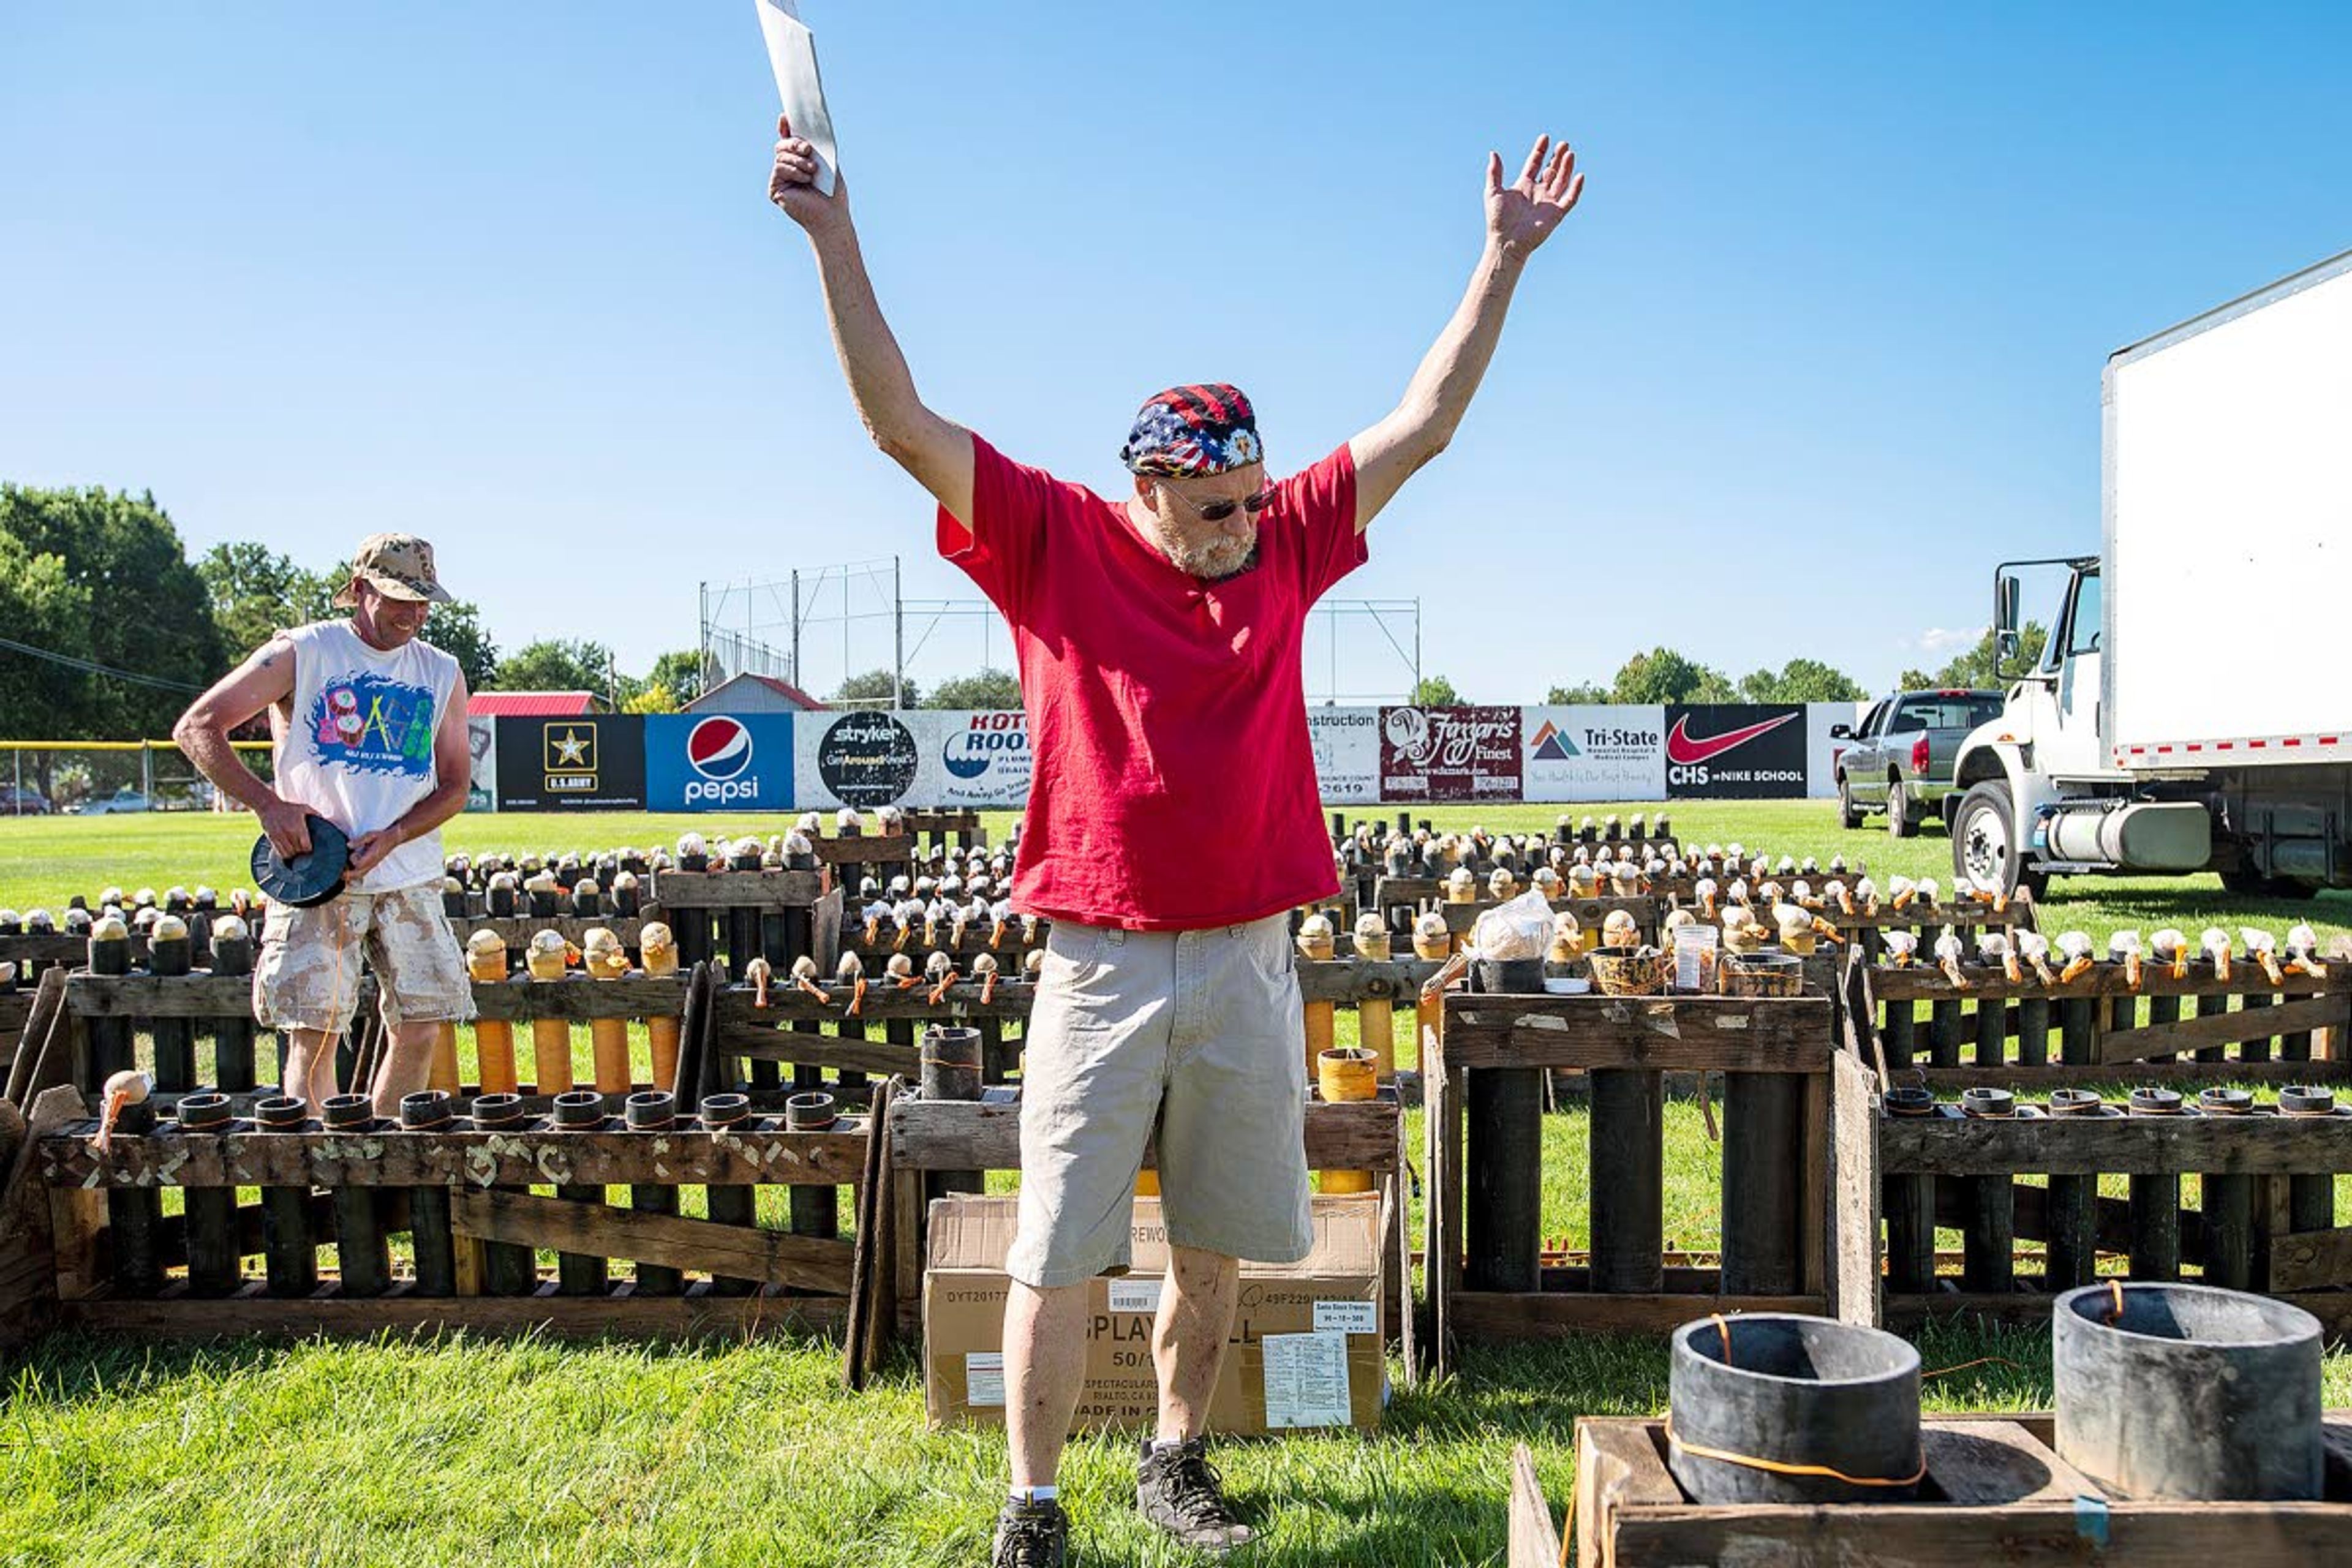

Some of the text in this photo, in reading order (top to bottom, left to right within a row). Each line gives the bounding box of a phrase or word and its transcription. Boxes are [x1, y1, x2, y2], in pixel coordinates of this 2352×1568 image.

[833, 725, 900, 744] stryker
[1585, 728, 1658, 746] Tri-State
[1476, 745, 1512, 760] Finest
[1668, 766, 1709, 785] CHS
[1721, 770, 1752, 782] NIKE
[1754, 770, 1804, 782] SCHOOL
[685, 775, 758, 805] pepsi
[1121, 1405, 1140, 1416] IN
